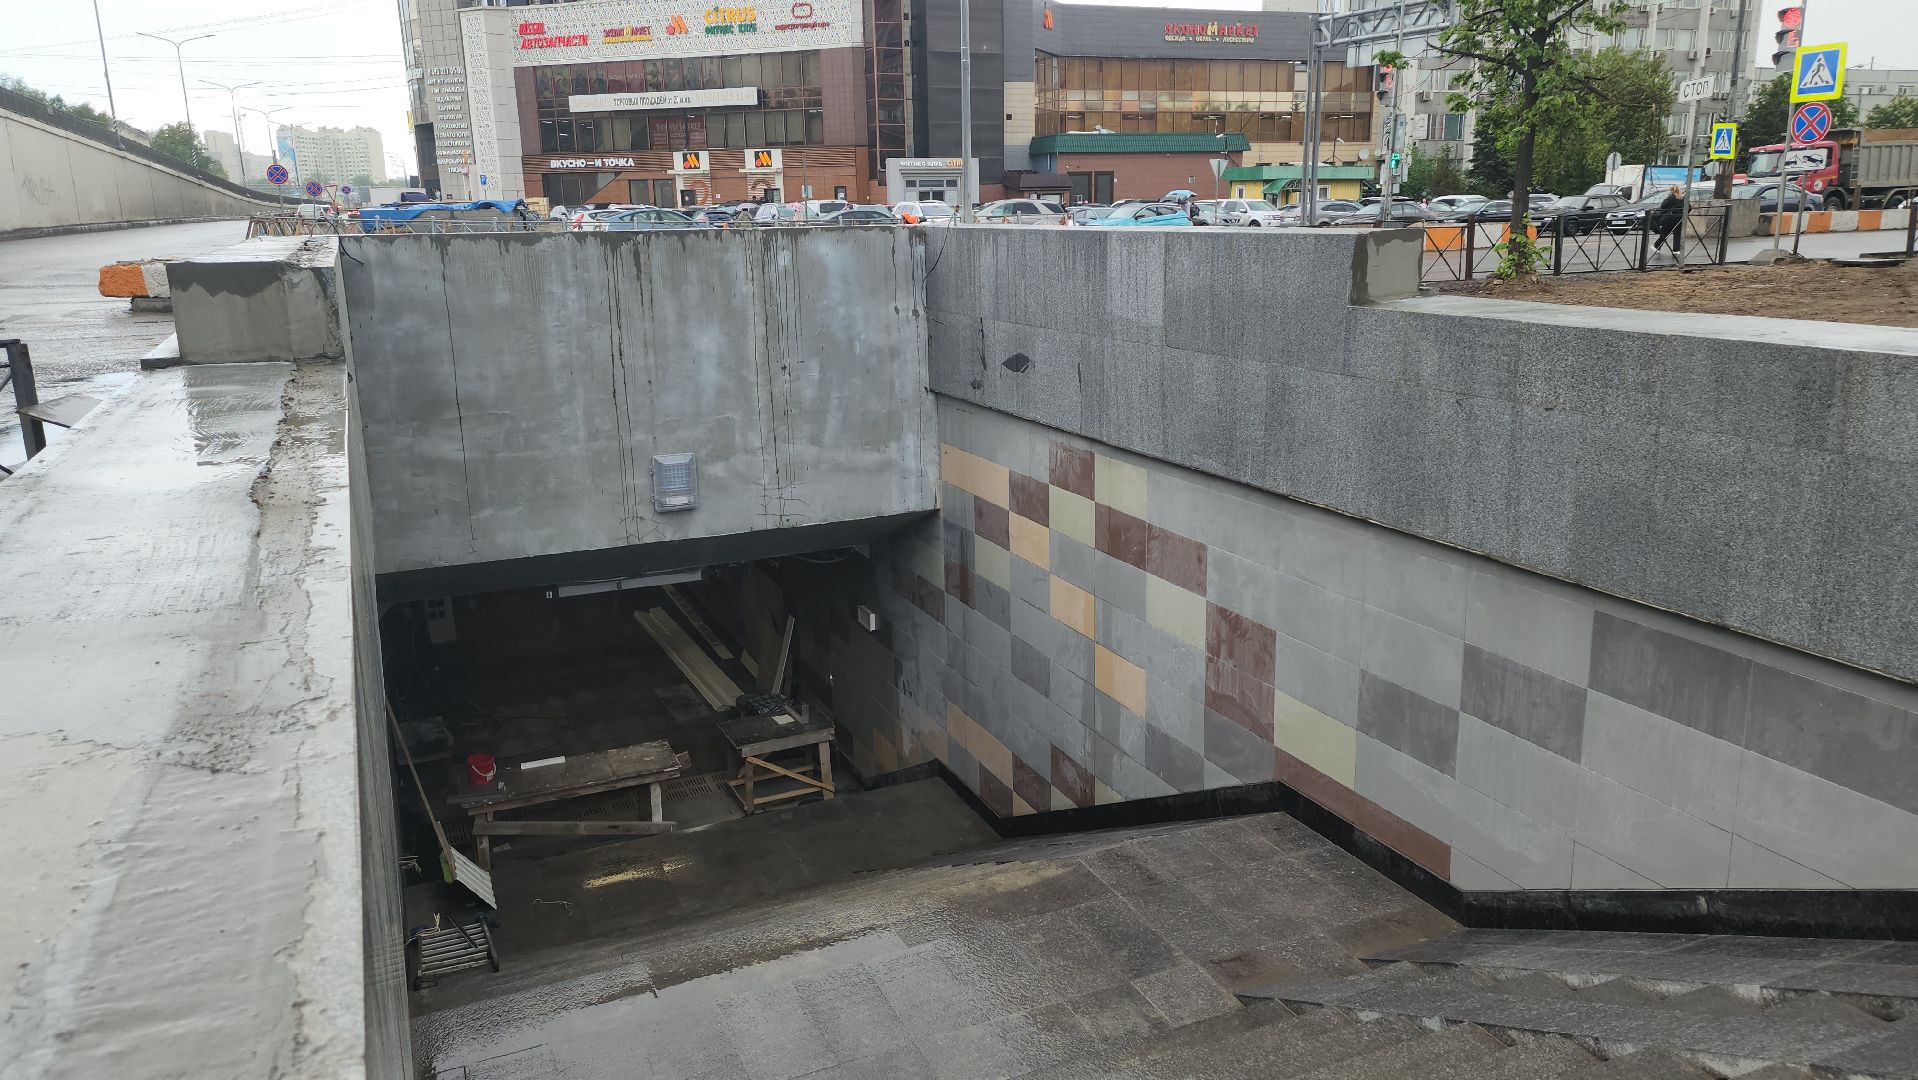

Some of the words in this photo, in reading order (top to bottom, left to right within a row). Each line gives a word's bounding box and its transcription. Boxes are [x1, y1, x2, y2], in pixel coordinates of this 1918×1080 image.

[704, 6, 757, 24] CITRUS
[705, 24, 734, 35] ФИТНЕС
[738, 22, 757, 33] КЛУБ
[1165, 21, 1259, 36] ЭКОНОМАРКЕТ
[521, 33, 589, 50] АВТОЗАПЧАСТИ
[1683, 80, 1709, 98] СТОП
[550, 158, 586, 169] ВКУСНО
[603, 157, 634, 167] ТОЧКА
